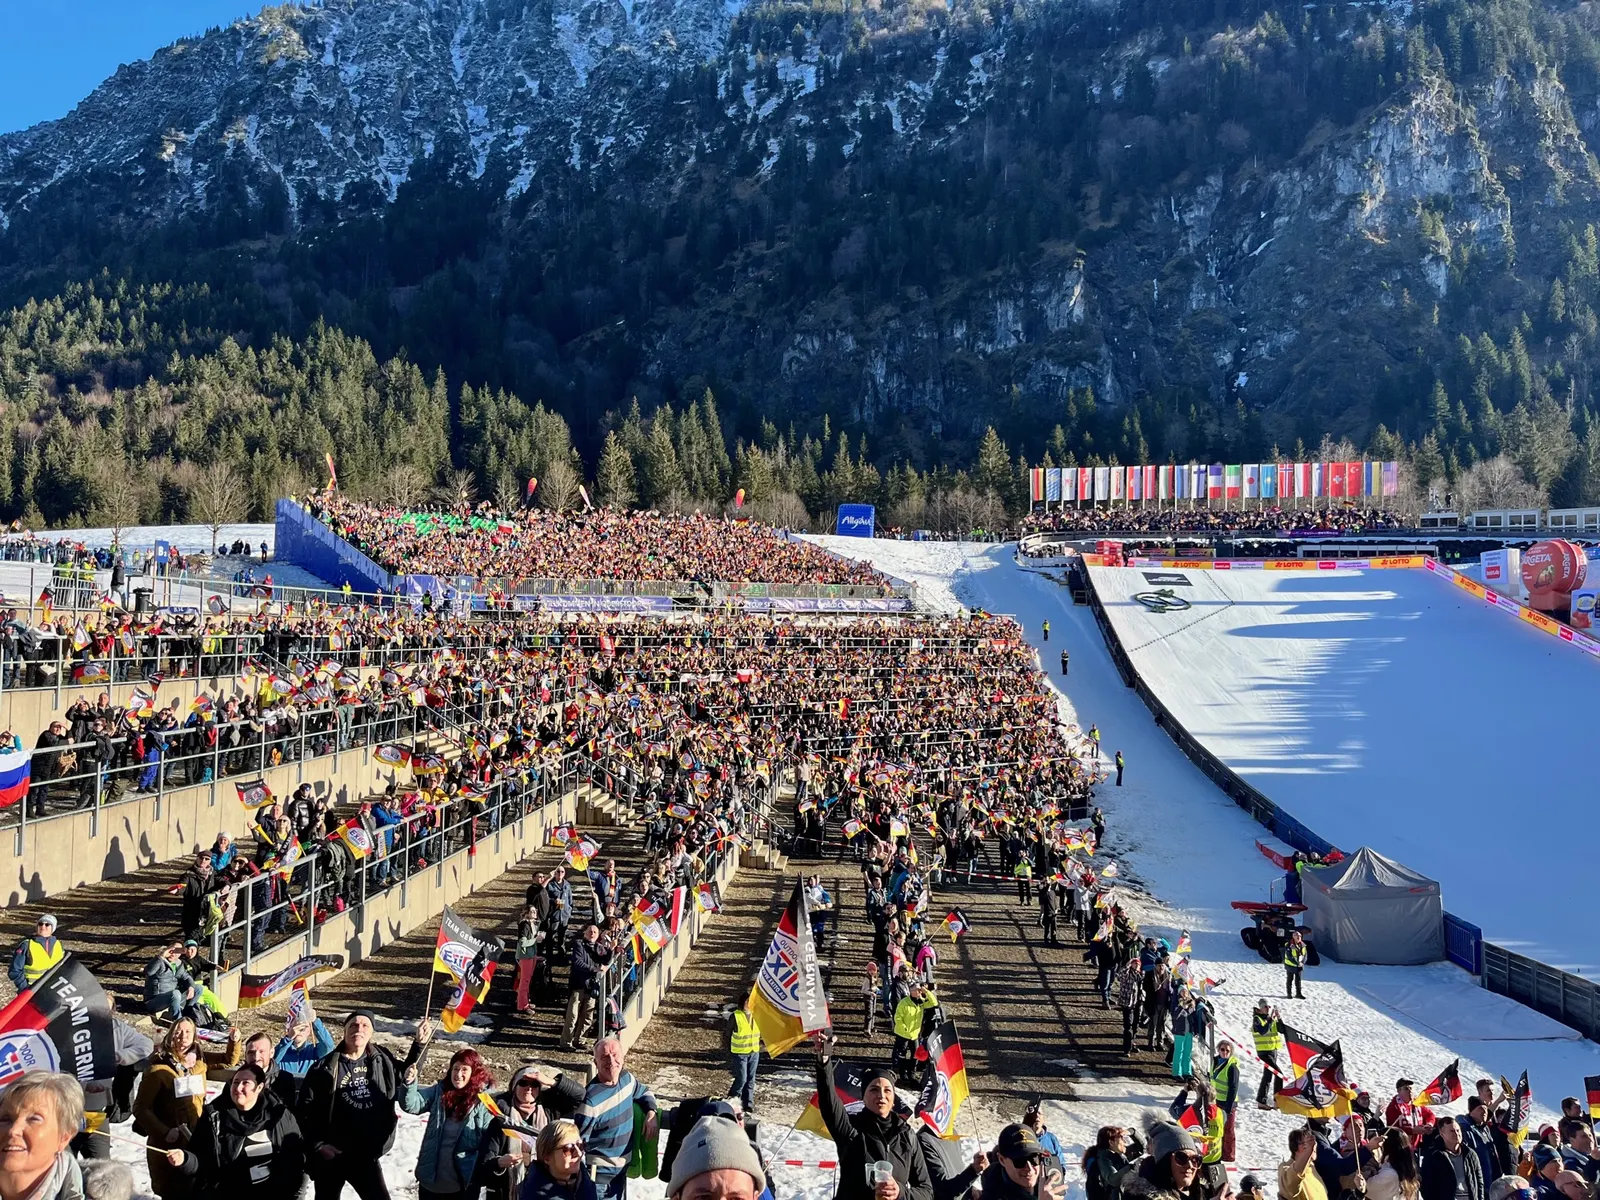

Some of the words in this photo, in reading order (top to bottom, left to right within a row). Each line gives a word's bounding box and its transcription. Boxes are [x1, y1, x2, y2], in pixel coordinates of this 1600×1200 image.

[1533, 614, 1548, 626] LOTTO
[445, 916, 460, 934] TEAM
[460, 930, 499, 952] GERMANY
[780, 939, 798, 963] OUTDO
[50, 975, 90, 1026] TEAM
[72, 1028, 95, 1081] GERM
[1296, 1032, 1315, 1043] TEA
[846, 1073, 862, 1087] TEA
